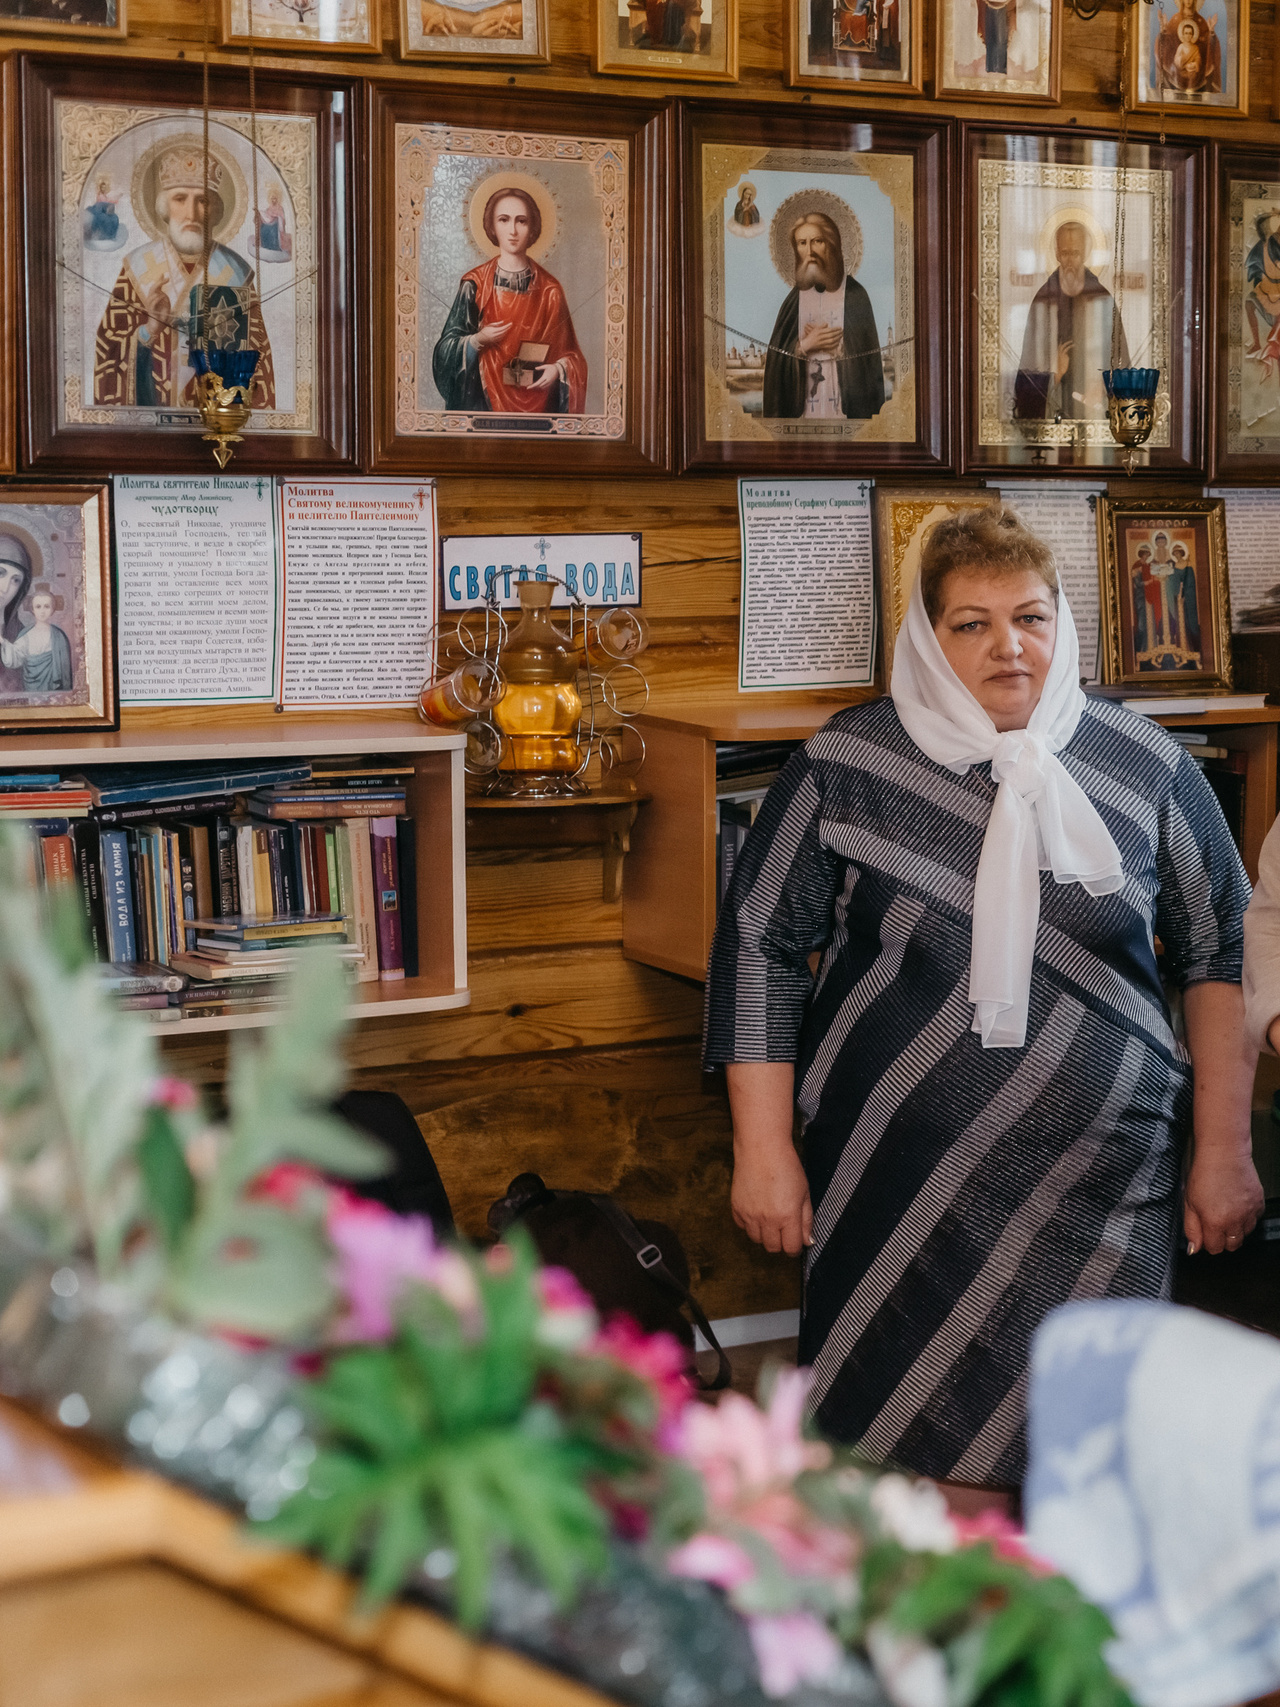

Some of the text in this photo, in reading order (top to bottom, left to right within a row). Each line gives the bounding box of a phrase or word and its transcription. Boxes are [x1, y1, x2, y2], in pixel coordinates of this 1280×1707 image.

[120, 477, 249, 489] Молитва святителю Николаю
[288, 486, 334, 496] Молитва
[746, 488, 790, 497] Молитва
[288, 498, 415, 512] Святому великомученику
[746, 497, 867, 510] преподобному Серафиму Саровскому
[151, 505, 218, 516] чудотворцу
[298, 512, 348, 521] целителю
[351, 511, 419, 522] Пантелеимону
[566, 562, 634, 602] ВОДА
[112, 842, 129, 927] ВОДА ИЗ КАМНЯ
